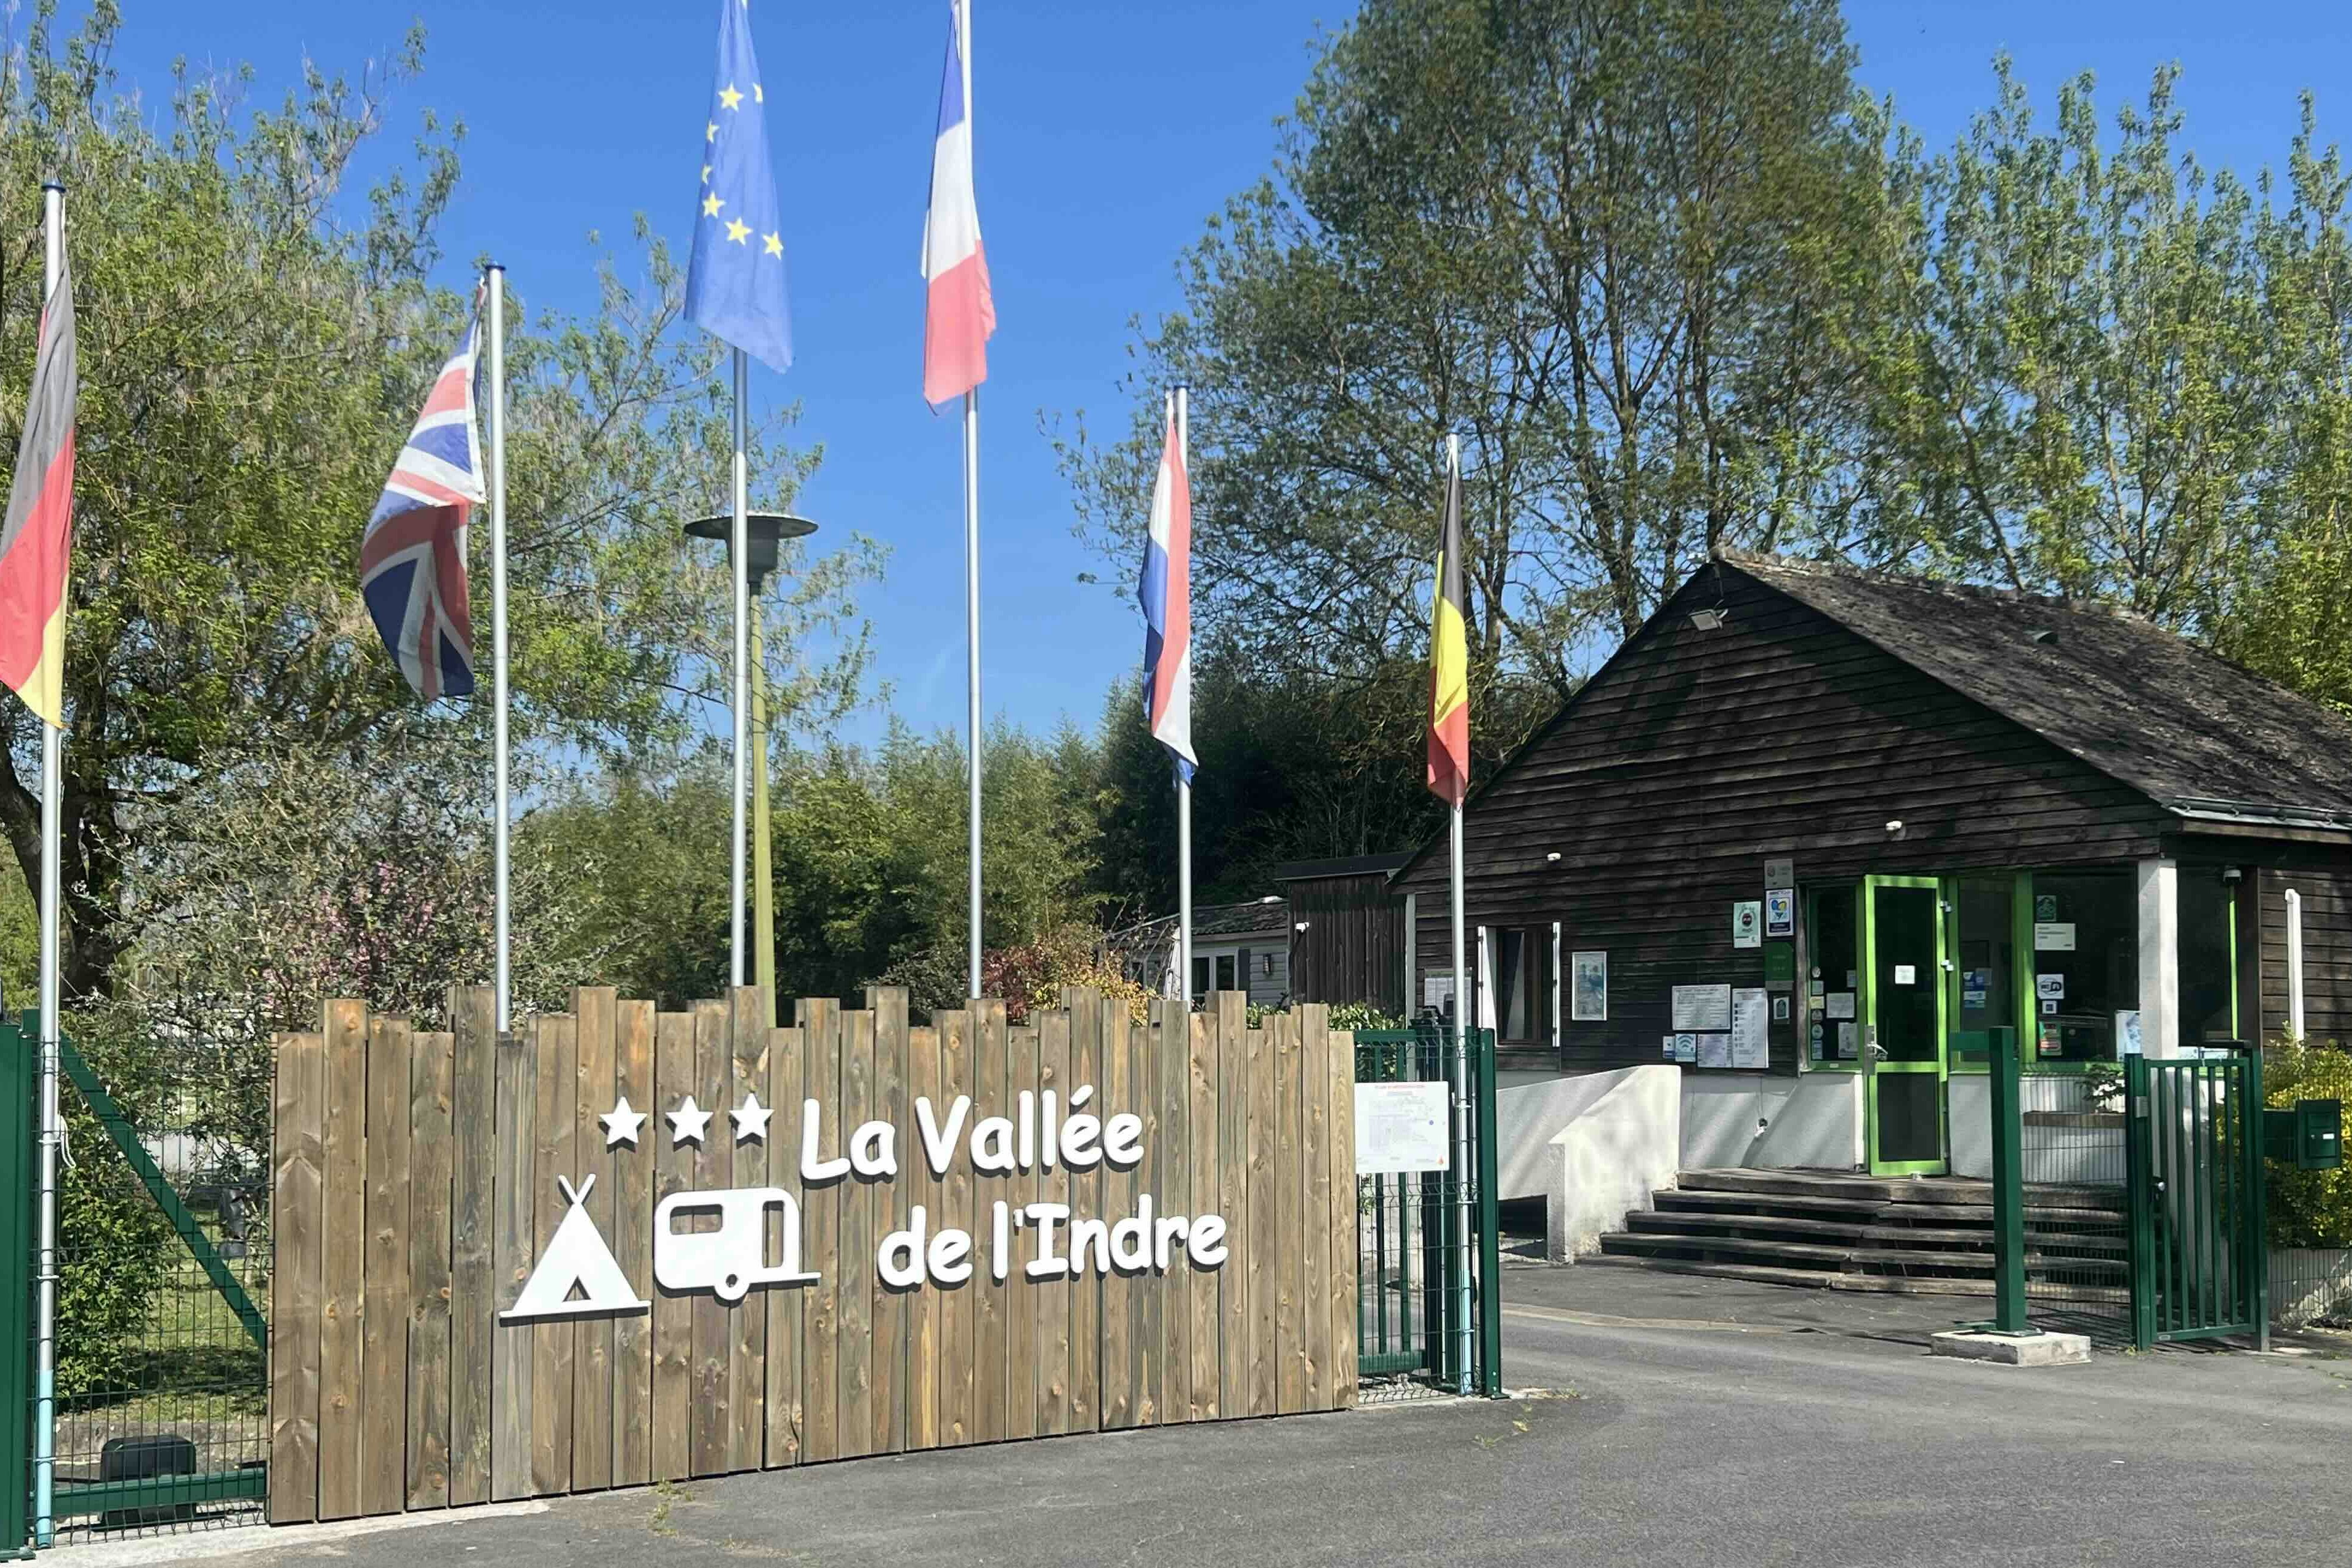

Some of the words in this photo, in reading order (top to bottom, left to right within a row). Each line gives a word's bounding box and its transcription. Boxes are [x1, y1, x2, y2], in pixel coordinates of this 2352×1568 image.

[801, 1099, 898, 1179] La
[915, 1085, 1144, 1173] Vallée
[878, 1205, 973, 1287] de
[993, 1194, 1229, 1279] l'Indre
